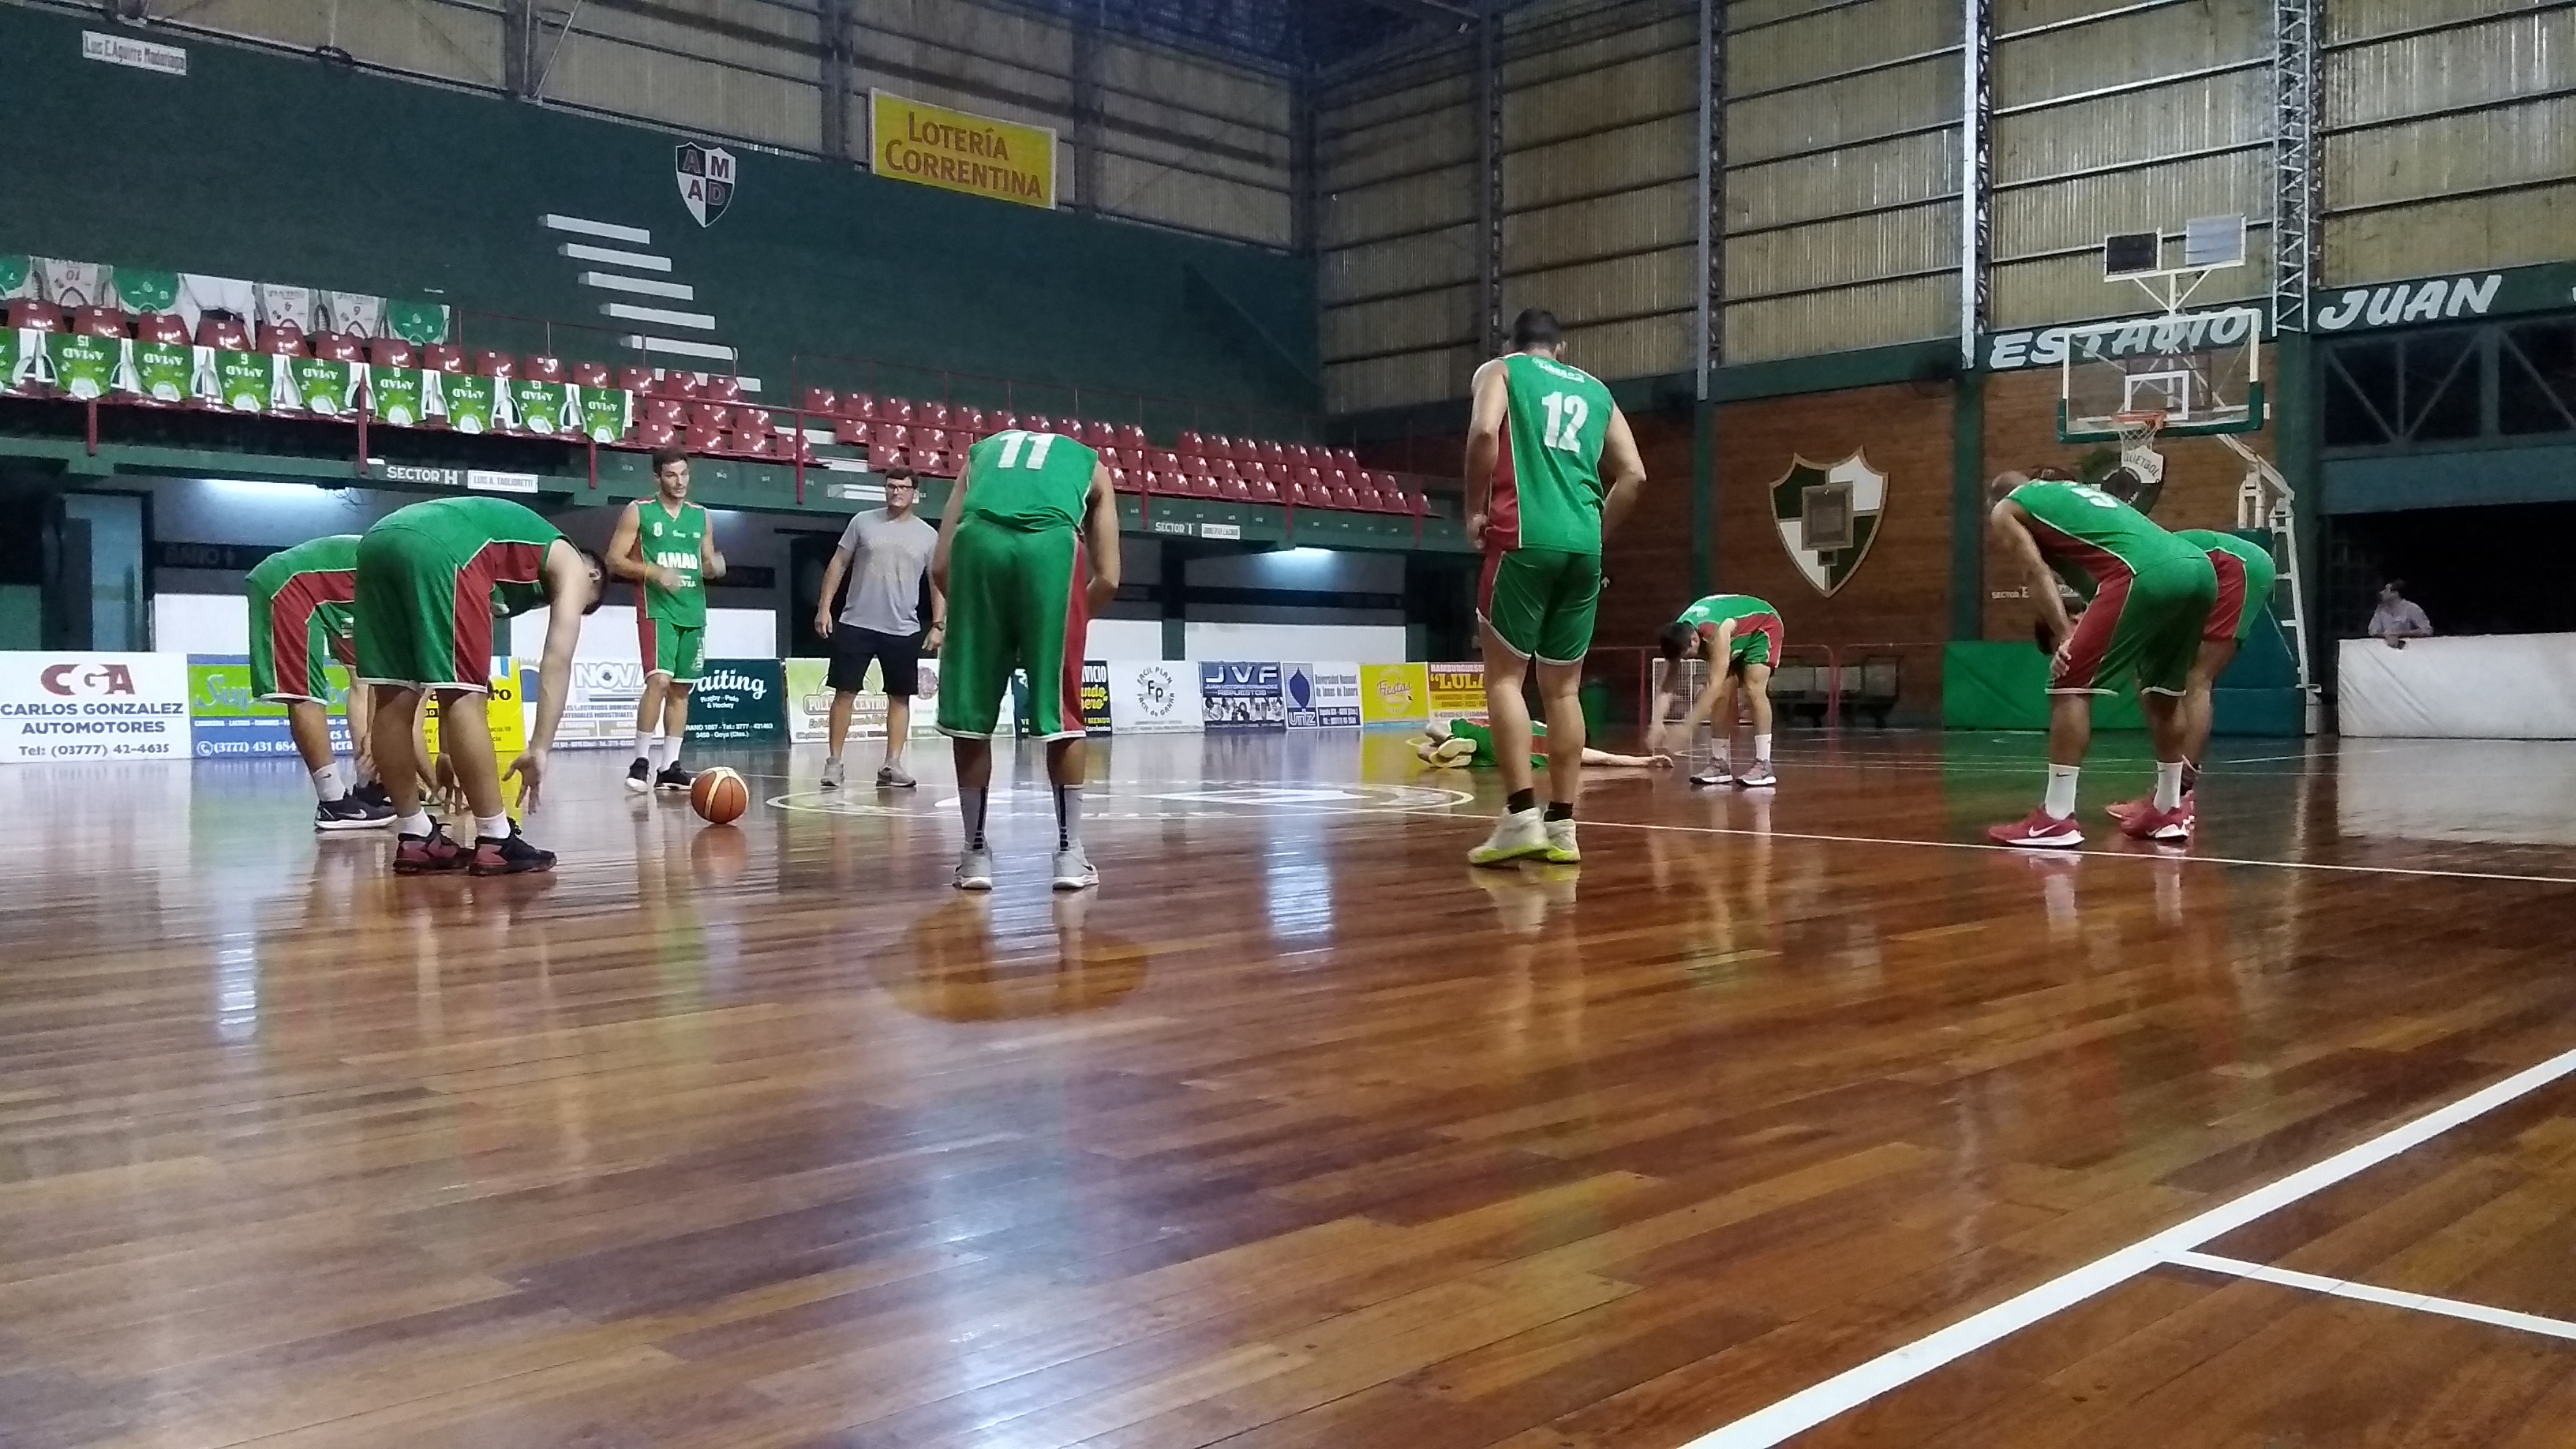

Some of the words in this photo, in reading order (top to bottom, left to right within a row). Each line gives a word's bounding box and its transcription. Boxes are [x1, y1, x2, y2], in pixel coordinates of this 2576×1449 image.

[908, 110, 1009, 161] LOTERÍA
[886, 139, 1042, 199] CORRENTINA
[2317, 275, 2502, 330] JUAN
[77, 335, 90, 347] 15
[62, 346, 104, 361] AMAD
[144, 353, 184, 366] AMAD
[226, 365, 264, 377] AMAD
[302, 368, 339, 380] AMAD
[380, 378, 415, 391] AMAD
[465, 376, 472, 387] 5
[452, 388, 485, 399] AMAD
[522, 391, 554, 402] AMAD
[600, 390, 606, 399] 7
[588, 401, 618, 412] AMAD
[1541, 391, 1589, 454] 12
[998, 432, 1056, 470] 11
[387, 466, 440, 482] SECTOR
[653, 521, 663, 537] 8
[1155, 522, 1185, 534] SECTOR
[657, 552, 698, 570] AMAD
[1155, 666, 1173, 684] PLAN
[1205, 666, 1277, 683] JVF
[688, 668, 767, 700] aiting
[1376, 679, 1413, 696] Fiestas
[1, 703, 78, 716] CARLOS
[83, 702, 184, 715] GONZALEZ
[853, 698, 886, 710] CENTRO
[21, 721, 166, 734] AUTOMOTORES
[19, 746, 46, 756] Tel:
[51, 744, 108, 758] (03777)
[113, 743, 170, 754] 42-4635
[214, 741, 249, 753] (3777)
[253, 741, 272, 751] 431
